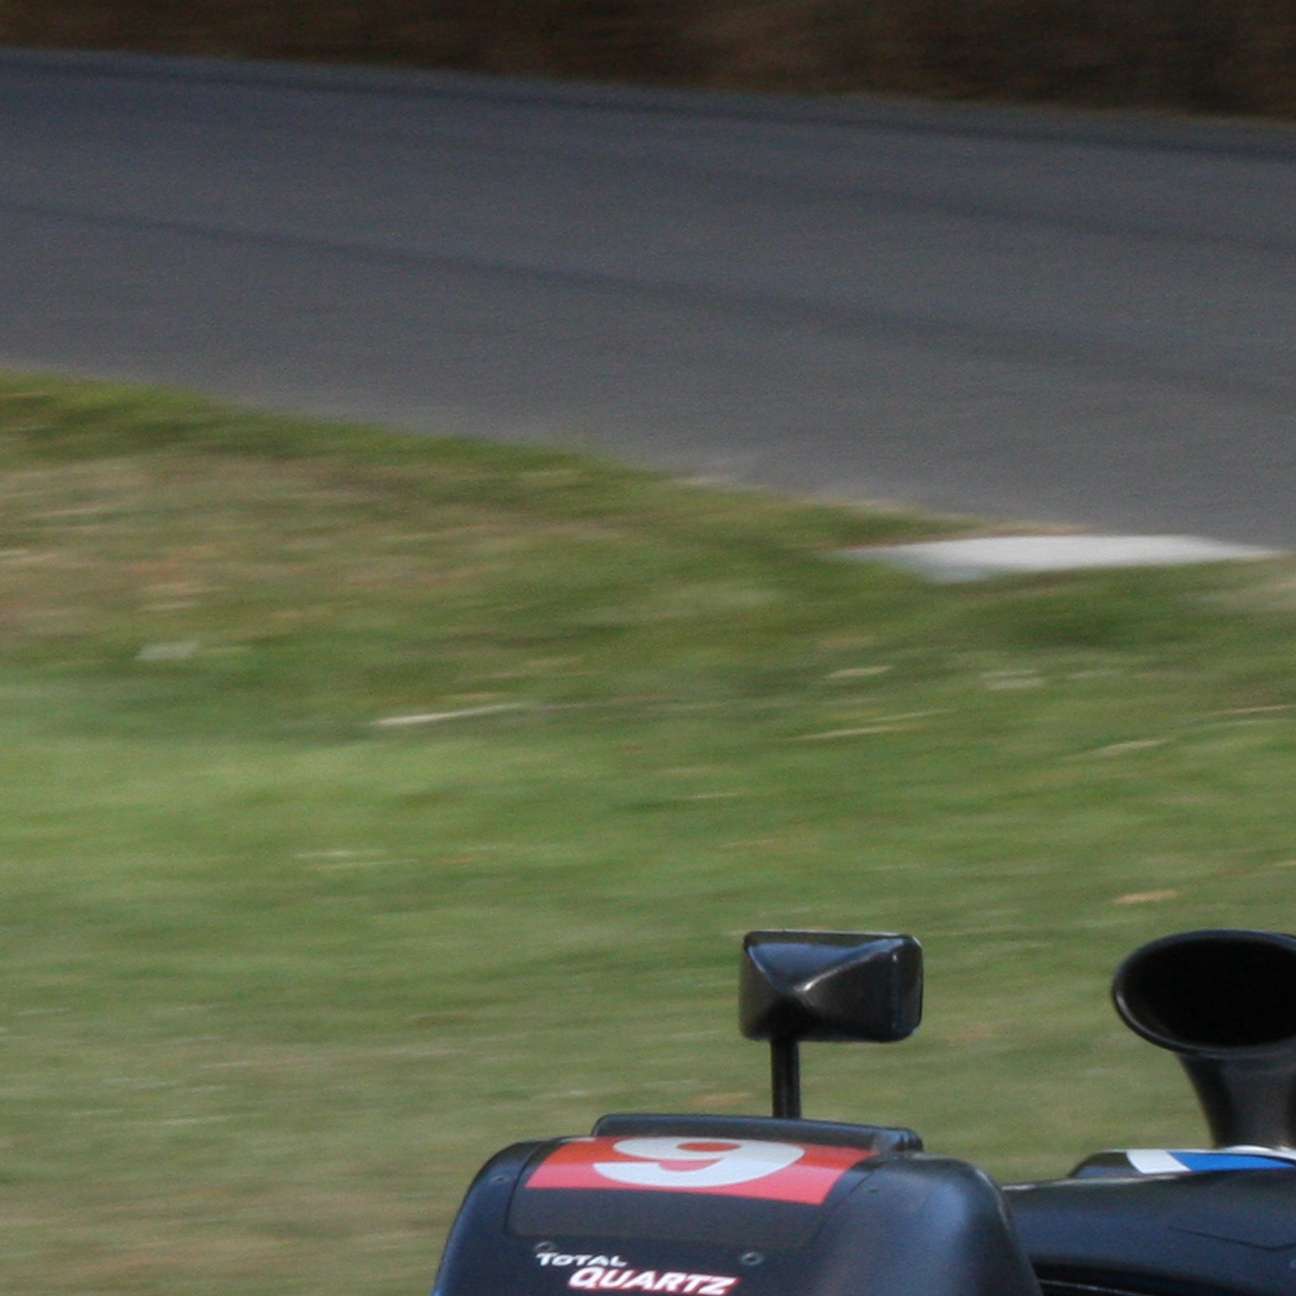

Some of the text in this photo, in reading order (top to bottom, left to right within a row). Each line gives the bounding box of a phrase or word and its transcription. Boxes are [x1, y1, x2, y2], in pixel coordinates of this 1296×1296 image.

[592, 1136, 805, 1188] 9
[535, 1252, 628, 1266] TOTAL
[568, 1266, 737, 1296] QUARTZ
